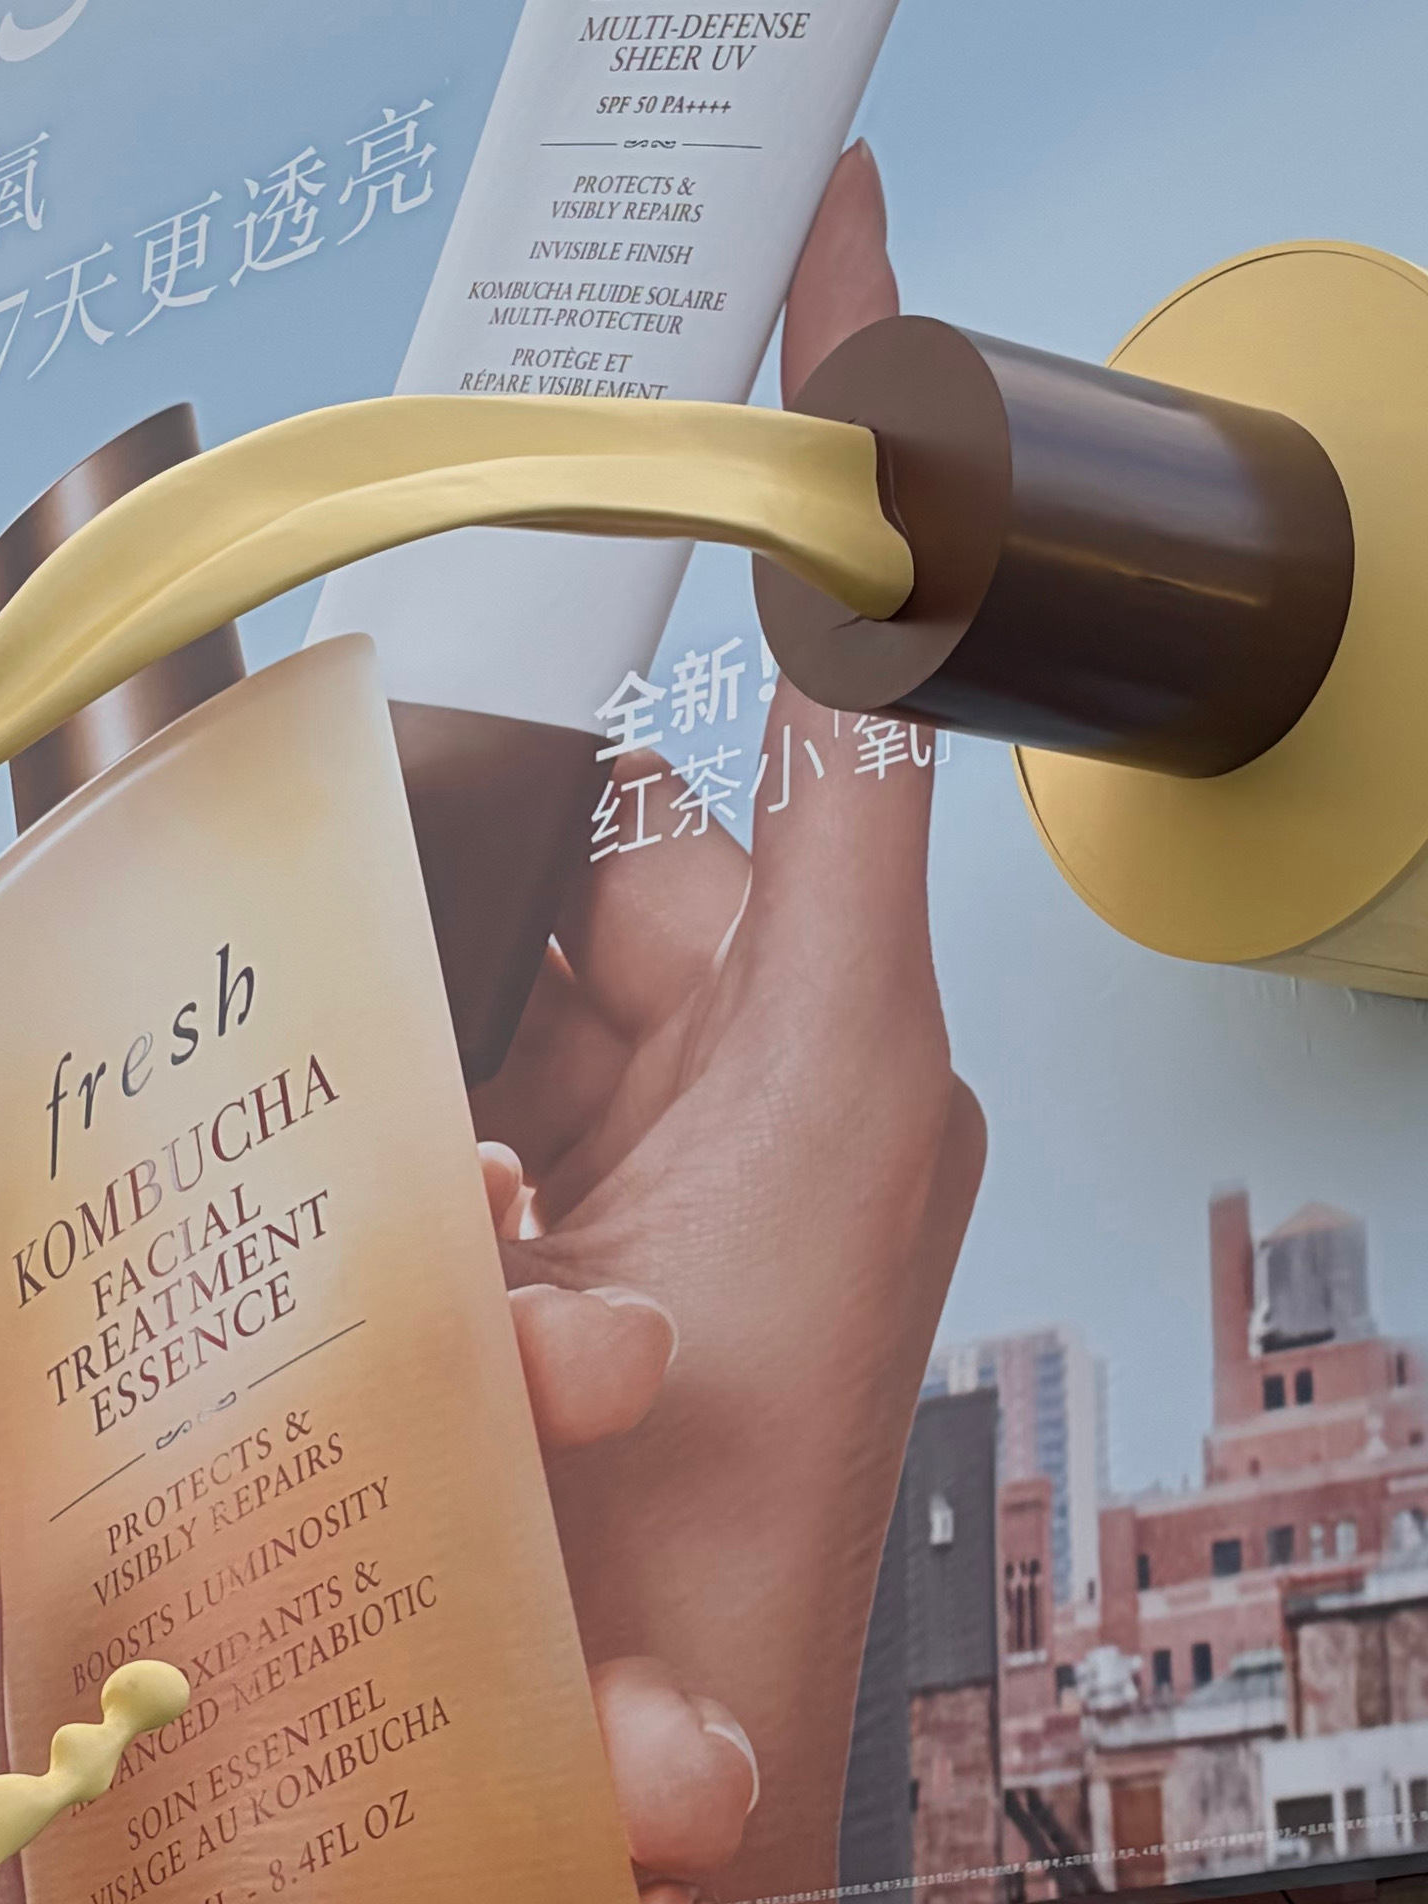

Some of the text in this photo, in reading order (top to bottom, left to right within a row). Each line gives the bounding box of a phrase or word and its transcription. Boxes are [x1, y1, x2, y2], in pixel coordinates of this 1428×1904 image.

[577, 11, 812, 41] MULTI-DEFENSE
[608, 44, 758, 72] SHEER UV
[595, 96, 732, 114] SPF 50 PA++++
[550, 200, 705, 224] VISIBLY REPAIRS
[571, 174, 697, 196] PROTECTS &
[467, 280, 728, 312] KOMBUCHA FLUIDE SOLAIRE
[528, 240, 694, 266] INVISIBLE FINISH
[459, 368, 532, 395] RÉPARE
[487, 306, 685, 335] MULTI-PROTECTEUR
[510, 345, 633, 374] PROTÈGE ET
[44, 942, 256, 1181] fresh
[10, 1053, 341, 1310] KOMBUCHA
[45, 1189, 330, 1408] TREATMENT
[90, 1182, 263, 1322] FACIAL
[88, 1270, 298, 1437] ESSENCE
[91, 1431, 345, 1609] VISIBLY REPAIRS
[105, 1407, 314, 1557] PROTECTS &
[71, 1475, 392, 1697] BOOSTS LUMINOSITY
[179, 1558, 383, 1690] XIDANTS &
[71, 1574, 440, 1817] ANCED METABIOTIC
[125, 1677, 388, 1851] SOIN ESSENTIEL
[194, 1807, 240, 1860] AU
[249, 1694, 453, 1830] KOMBUCHA
[267, 1824, 361, 1894] 8.4FL
[363, 1788, 417, 1843] OZ
